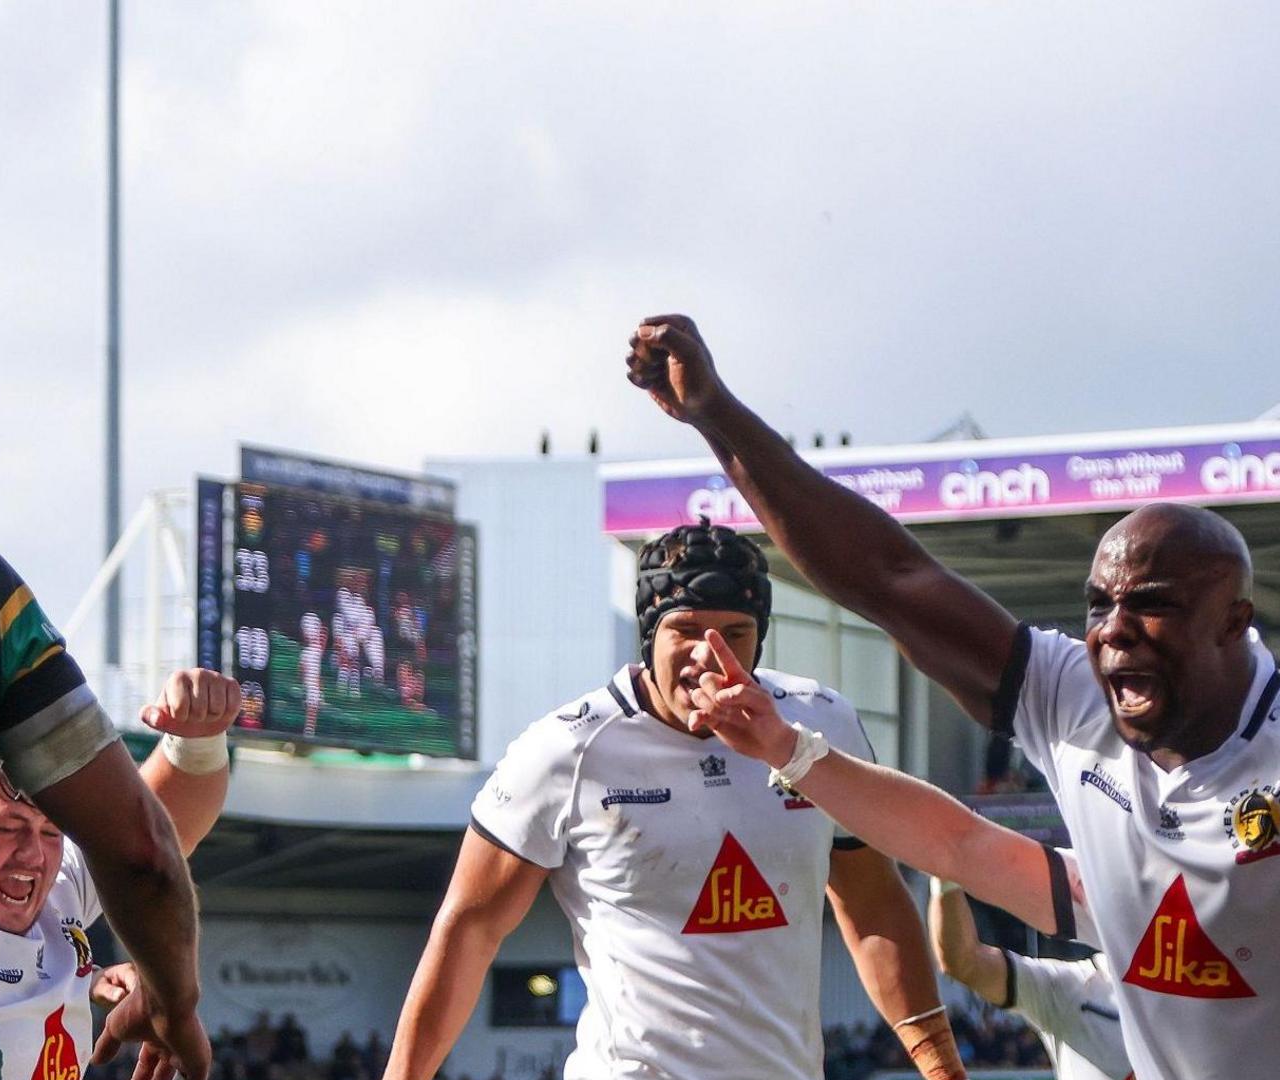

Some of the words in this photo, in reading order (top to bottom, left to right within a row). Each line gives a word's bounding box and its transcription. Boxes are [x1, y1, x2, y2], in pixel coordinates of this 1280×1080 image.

[686, 475, 748, 524] cin
[941, 458, 1050, 509] cinch
[698, 864, 776, 926] Sika
[1139, 916, 1231, 986] Sika
